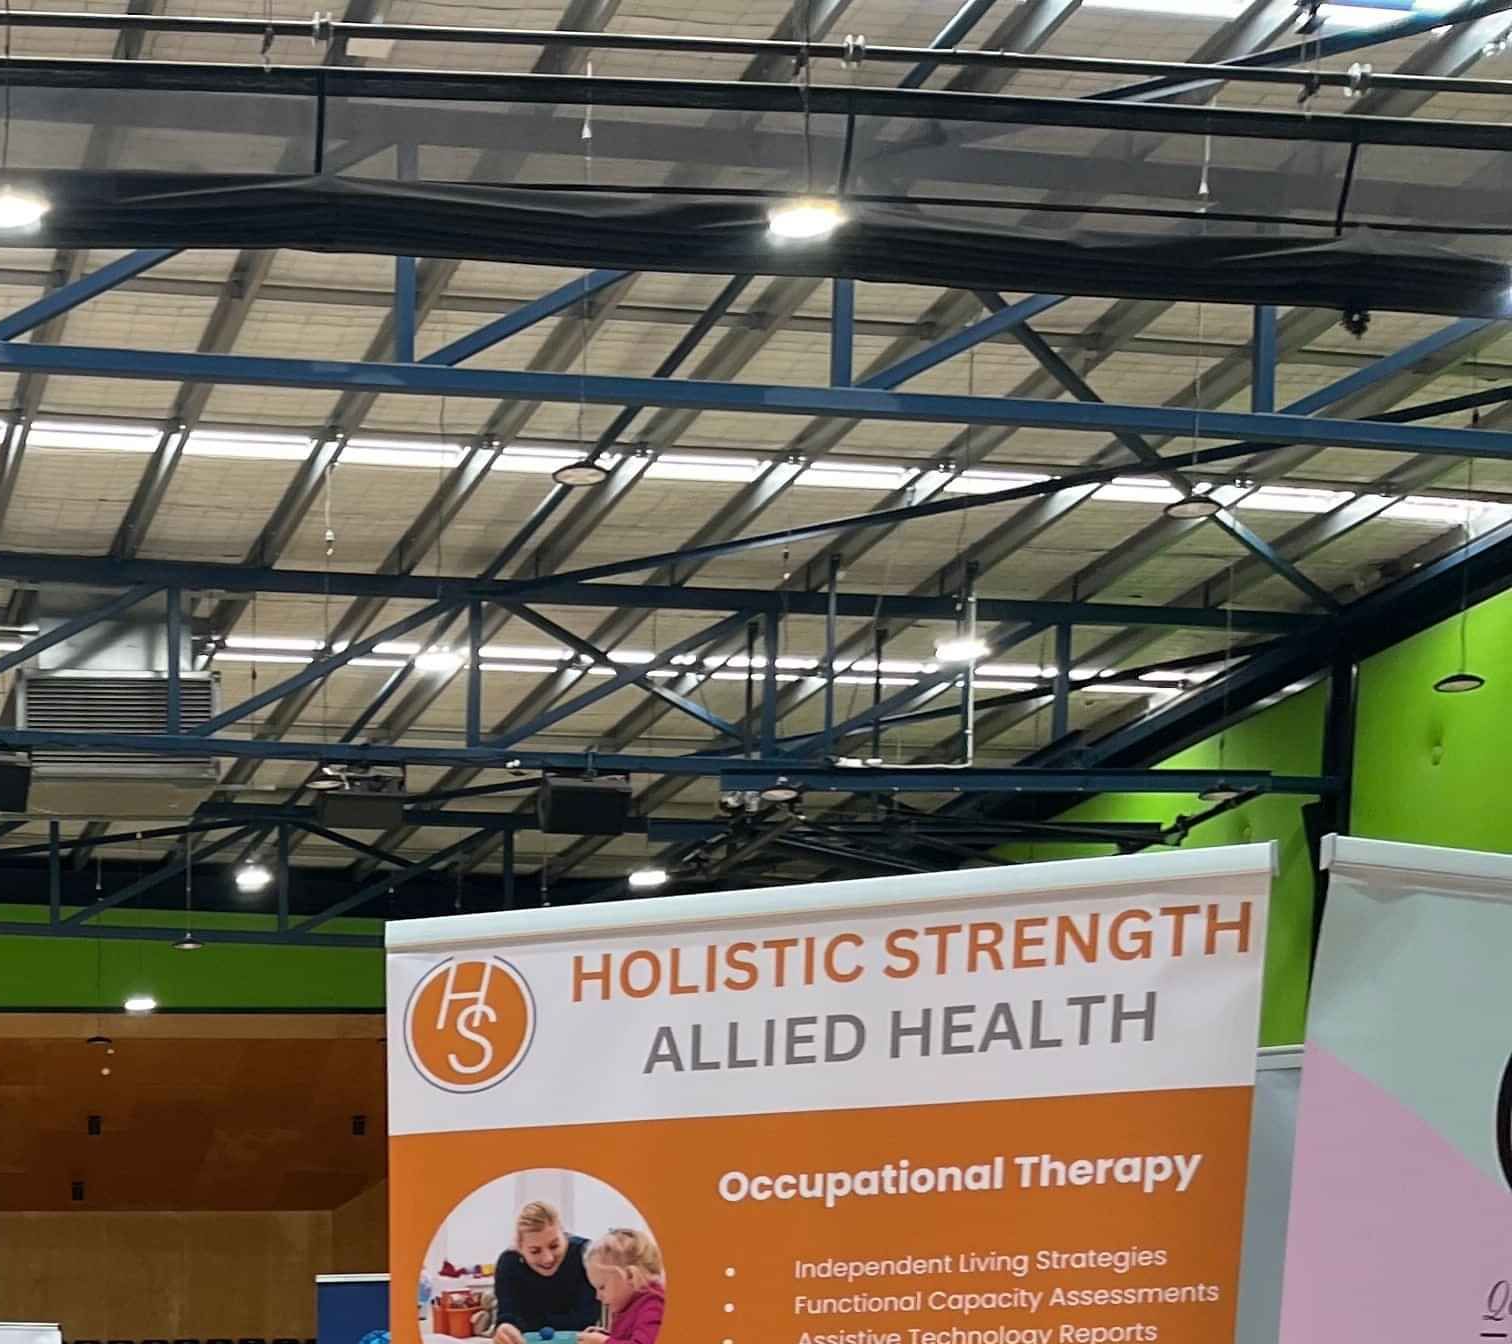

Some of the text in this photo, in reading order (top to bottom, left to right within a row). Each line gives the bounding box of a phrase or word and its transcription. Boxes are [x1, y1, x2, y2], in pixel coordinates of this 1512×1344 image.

[572, 901, 1252, 1002] HOLISTIC STRENGTH
[643, 991, 1157, 1074] ALLIED HEALTH
[718, 1153, 1202, 1208] Occupational Therapy
[794, 1246, 1168, 1283] Independent Living Strategies
[794, 1282, 1220, 1316] Functional Capacity Assessments
